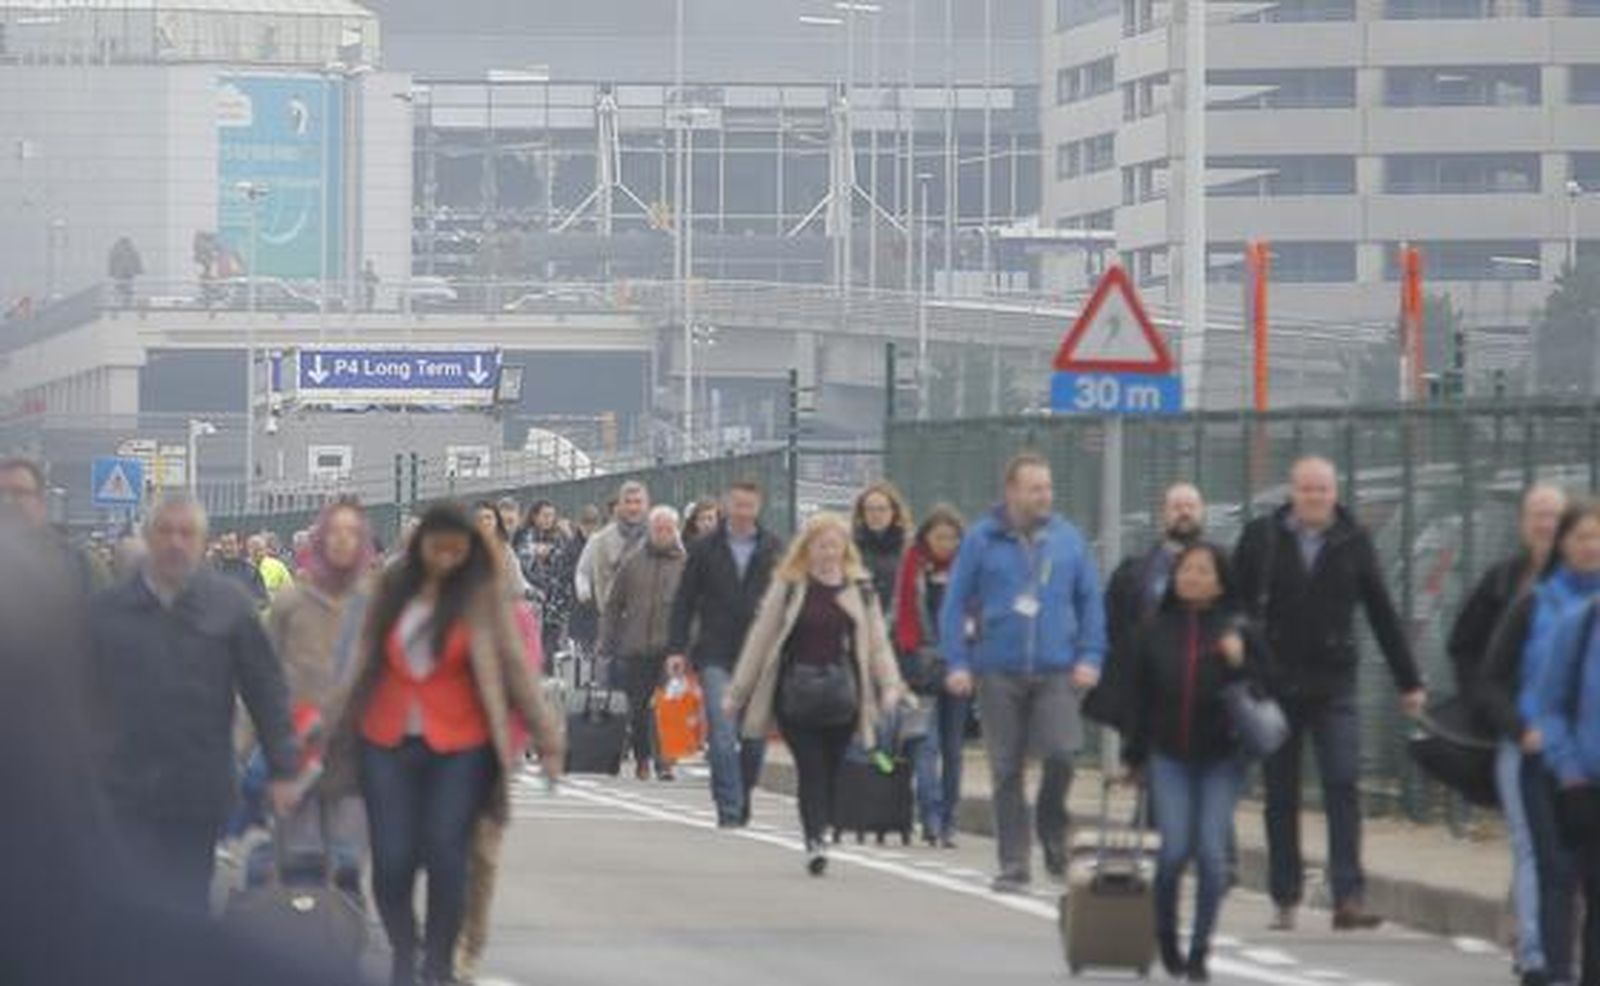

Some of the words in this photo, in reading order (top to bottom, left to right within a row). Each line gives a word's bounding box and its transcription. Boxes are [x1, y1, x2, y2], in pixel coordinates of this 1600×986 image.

[334, 359, 358, 375] P4
[364, 359, 411, 380] Long
[416, 359, 462, 376] Term
[1073, 374, 1119, 409] 30
[1126, 385, 1160, 410] m
